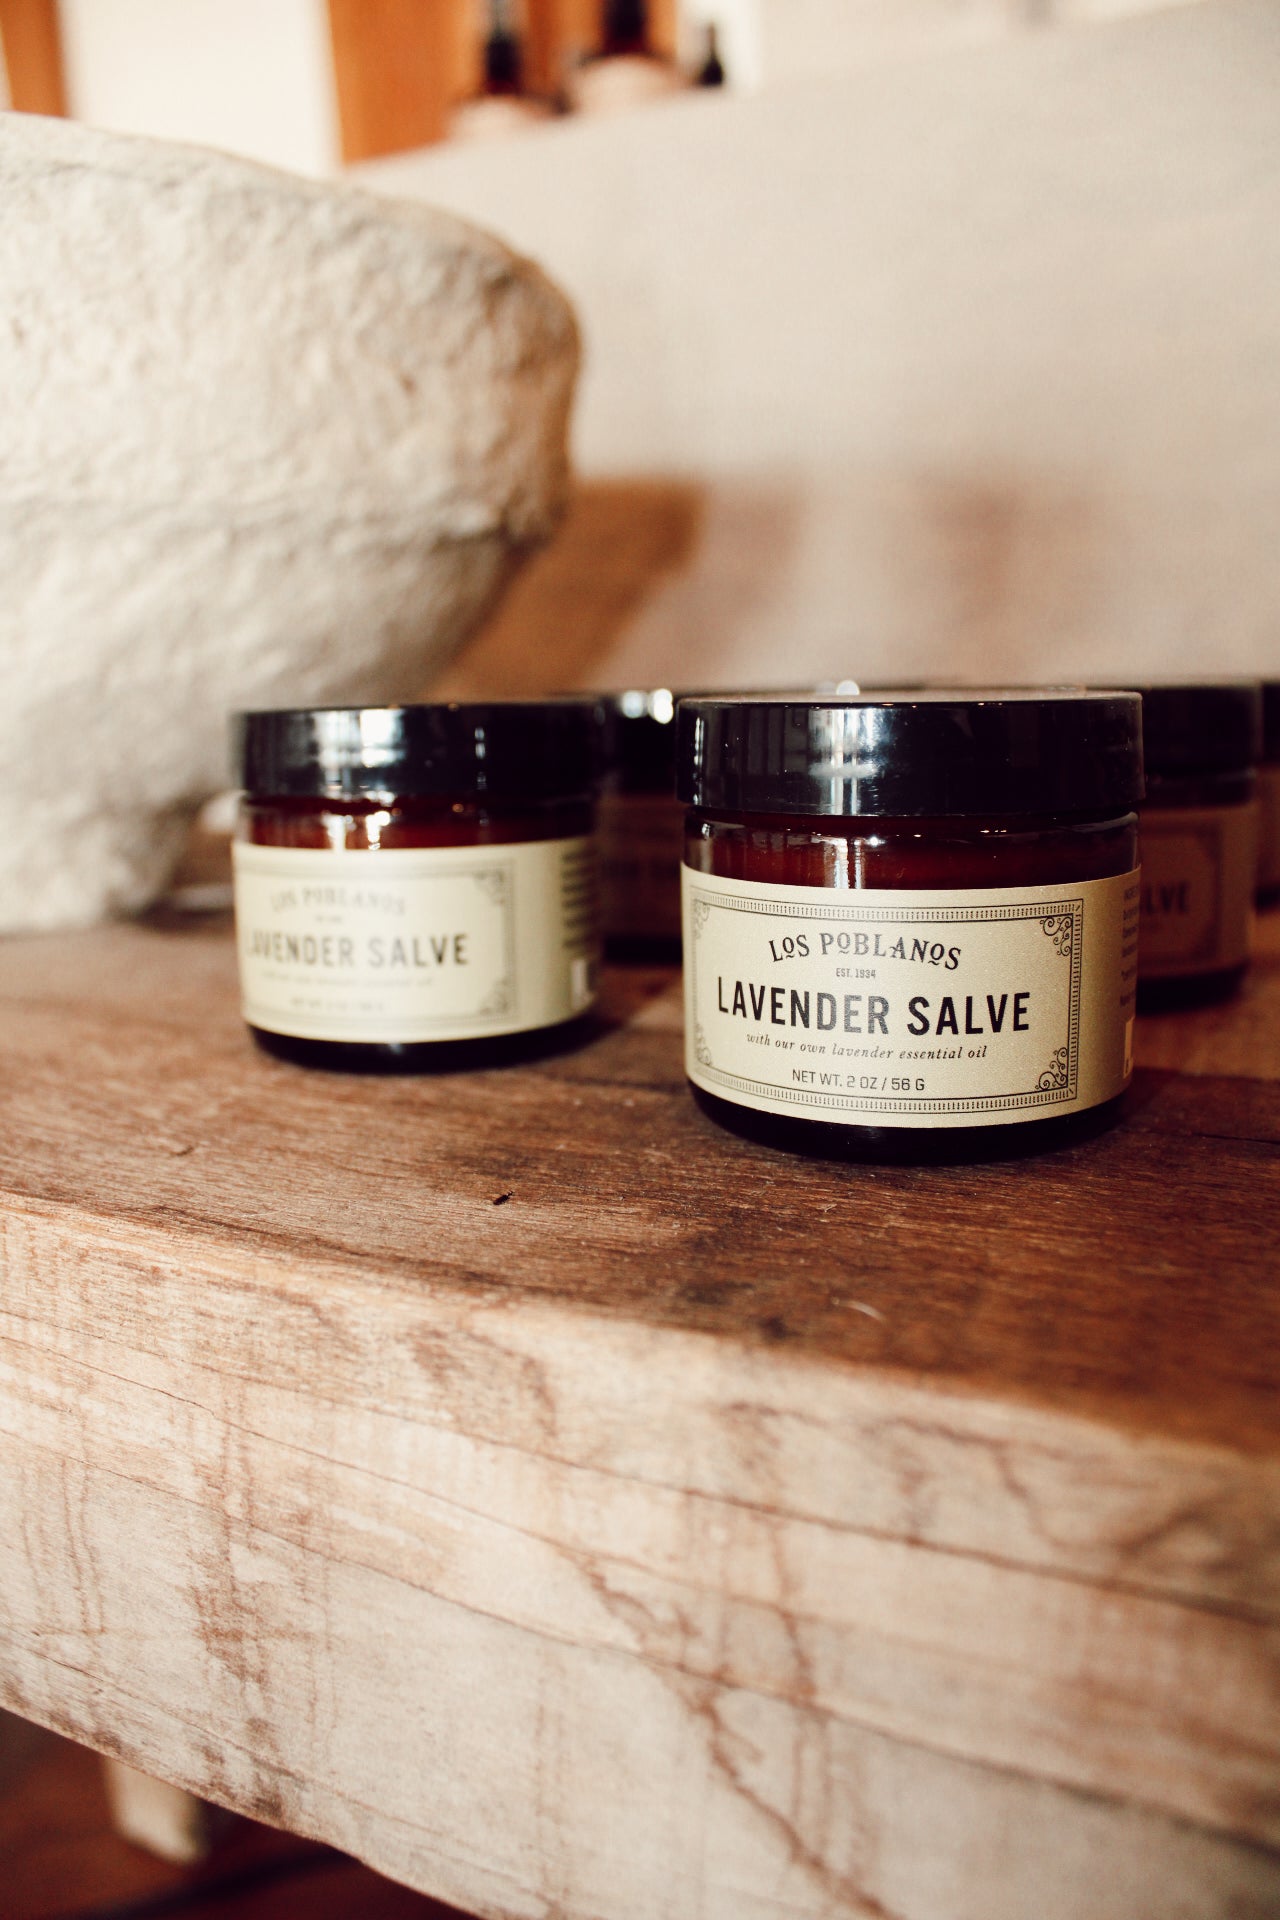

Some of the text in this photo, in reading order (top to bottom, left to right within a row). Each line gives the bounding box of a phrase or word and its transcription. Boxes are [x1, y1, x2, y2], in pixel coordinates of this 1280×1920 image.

[367, 933, 470, 968] SALVE
[768, 932, 962, 970] LOS POBLANOS
[835, 967, 852, 978] EST.
[718, 976, 1031, 1036] LAVENDER SALVE
[746, 1033, 988, 1060] with our own lavender essential oil
[792, 1068, 816, 1084] NET
[819, 1072, 843, 1087] WT.
[846, 1075, 856, 1089] 2
[859, 1076, 878, 1090] OZ
[891, 1077, 911, 1091] 56
[915, 1078, 926, 1092] G
